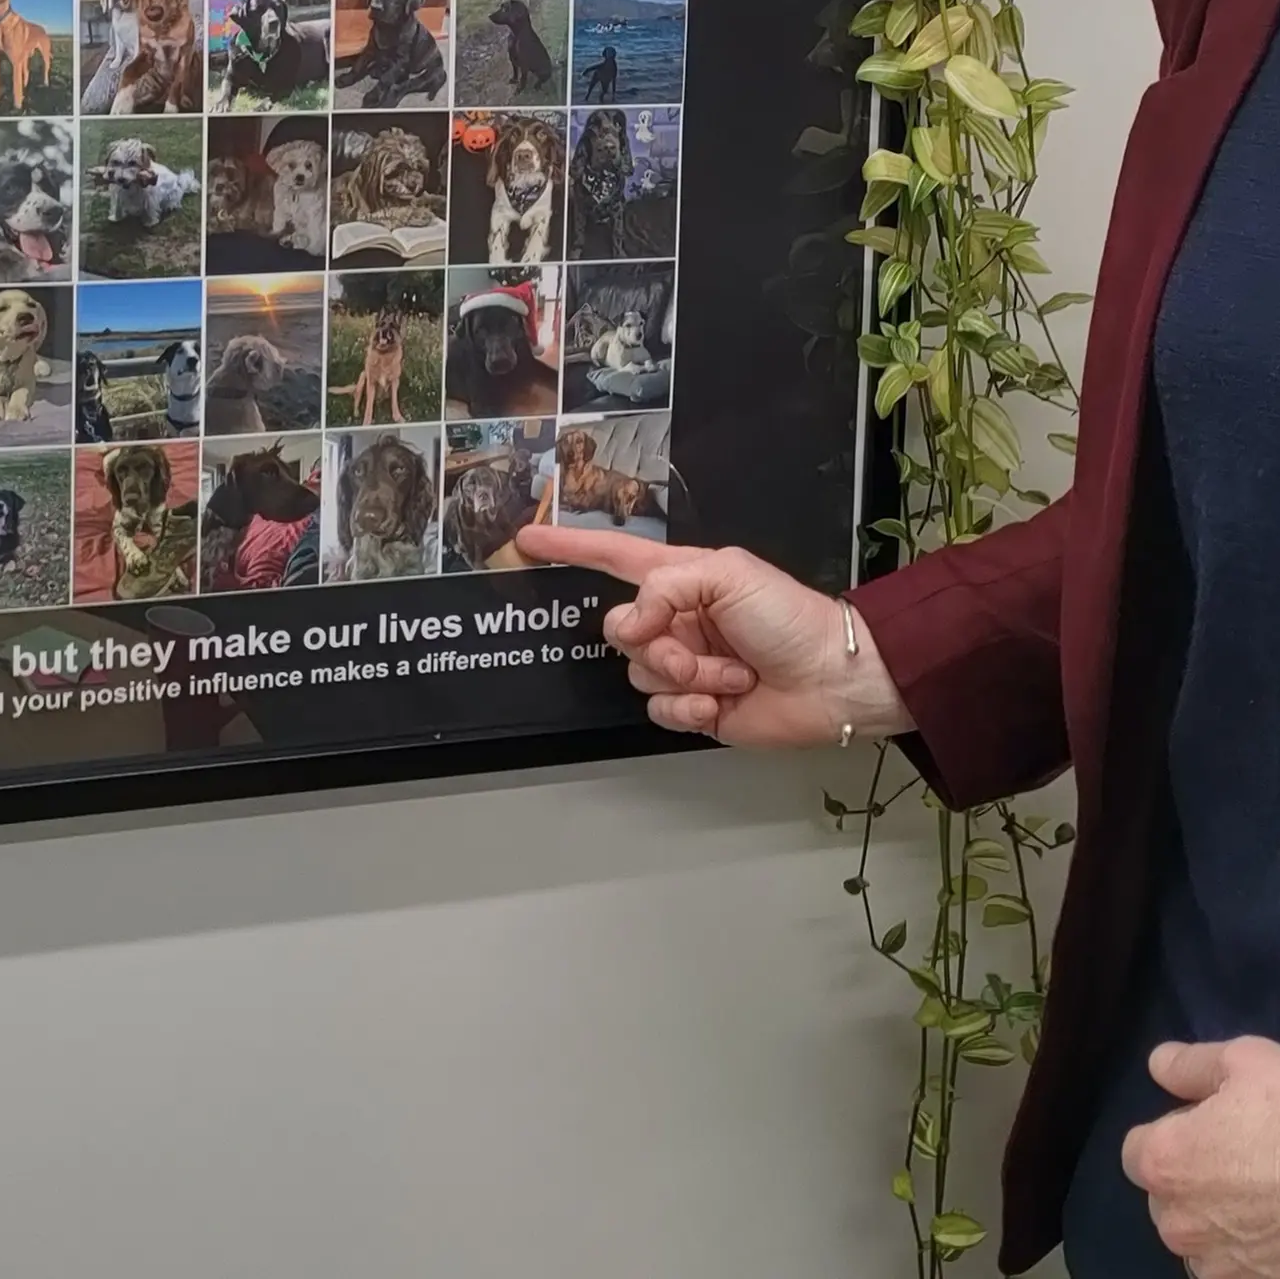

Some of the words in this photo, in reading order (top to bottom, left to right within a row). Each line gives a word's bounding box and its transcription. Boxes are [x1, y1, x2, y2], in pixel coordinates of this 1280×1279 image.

[12, 641, 79, 678] but
[88, 637, 177, 674] they
[188, 624, 292, 662] make
[302, 622, 369, 651] our
[378, 612, 463, 645] lives
[473, 595, 599, 636] whole"
[11, 690, 74, 719] your
[80, 678, 182, 712] positive
[189, 669, 304, 696] influence
[310, 659, 390, 685] makes
[395, 659, 411, 677] a
[416, 650, 535, 675] difference
[540, 643, 565, 664] to
[570, 642, 610, 660] our
